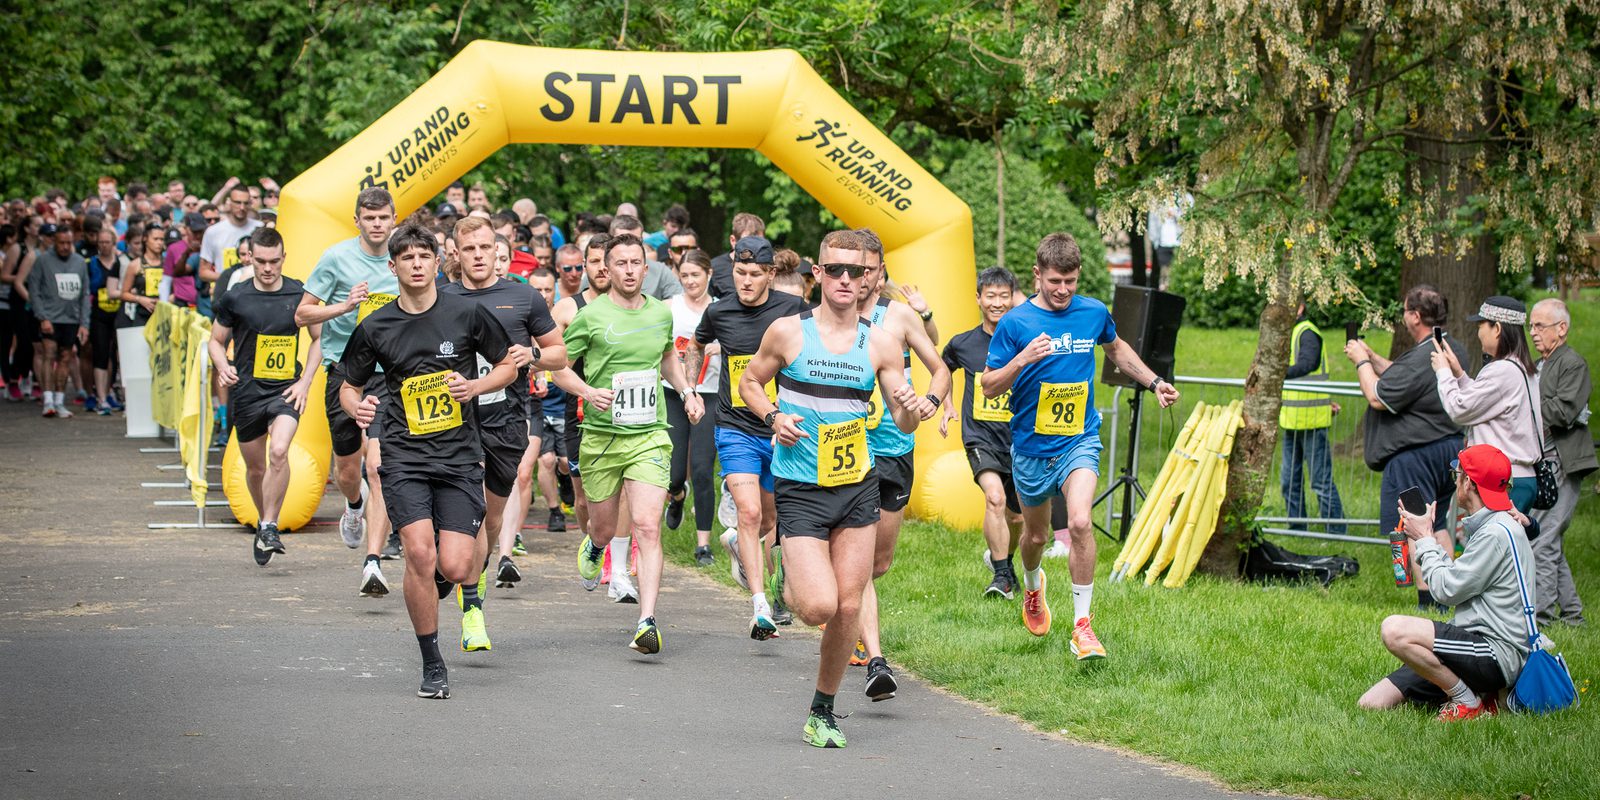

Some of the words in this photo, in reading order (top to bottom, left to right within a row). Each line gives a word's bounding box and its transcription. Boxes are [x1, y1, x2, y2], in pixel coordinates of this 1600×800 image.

[540, 71, 742, 125] START
[387, 138, 412, 166] UP
[413, 106, 450, 146] AND
[391, 112, 471, 188] RUNNING
[421, 145, 458, 181] EVENTS
[847, 139, 875, 160] UP
[869, 159, 913, 191] AND
[825, 146, 912, 212] RUNNING
[836, 175, 878, 207] EVENTS
[858, 332, 866, 349] soar
[265, 352, 286, 369] 60
[807, 359, 864, 372] Kirkintilloch
[417, 380, 449, 393] RUNNING
[429, 374, 445, 383] AND
[809, 370, 861, 382] Olympians
[615, 386, 656, 409] 4116
[1055, 389, 1085, 398] RUNNING
[415, 393, 453, 421] 123
[1051, 401, 1076, 424] 98
[833, 426, 861, 441] RUNNING
[837, 426, 847, 434] UP
[846, 421, 859, 432] AND
[832, 443, 856, 472] 55
